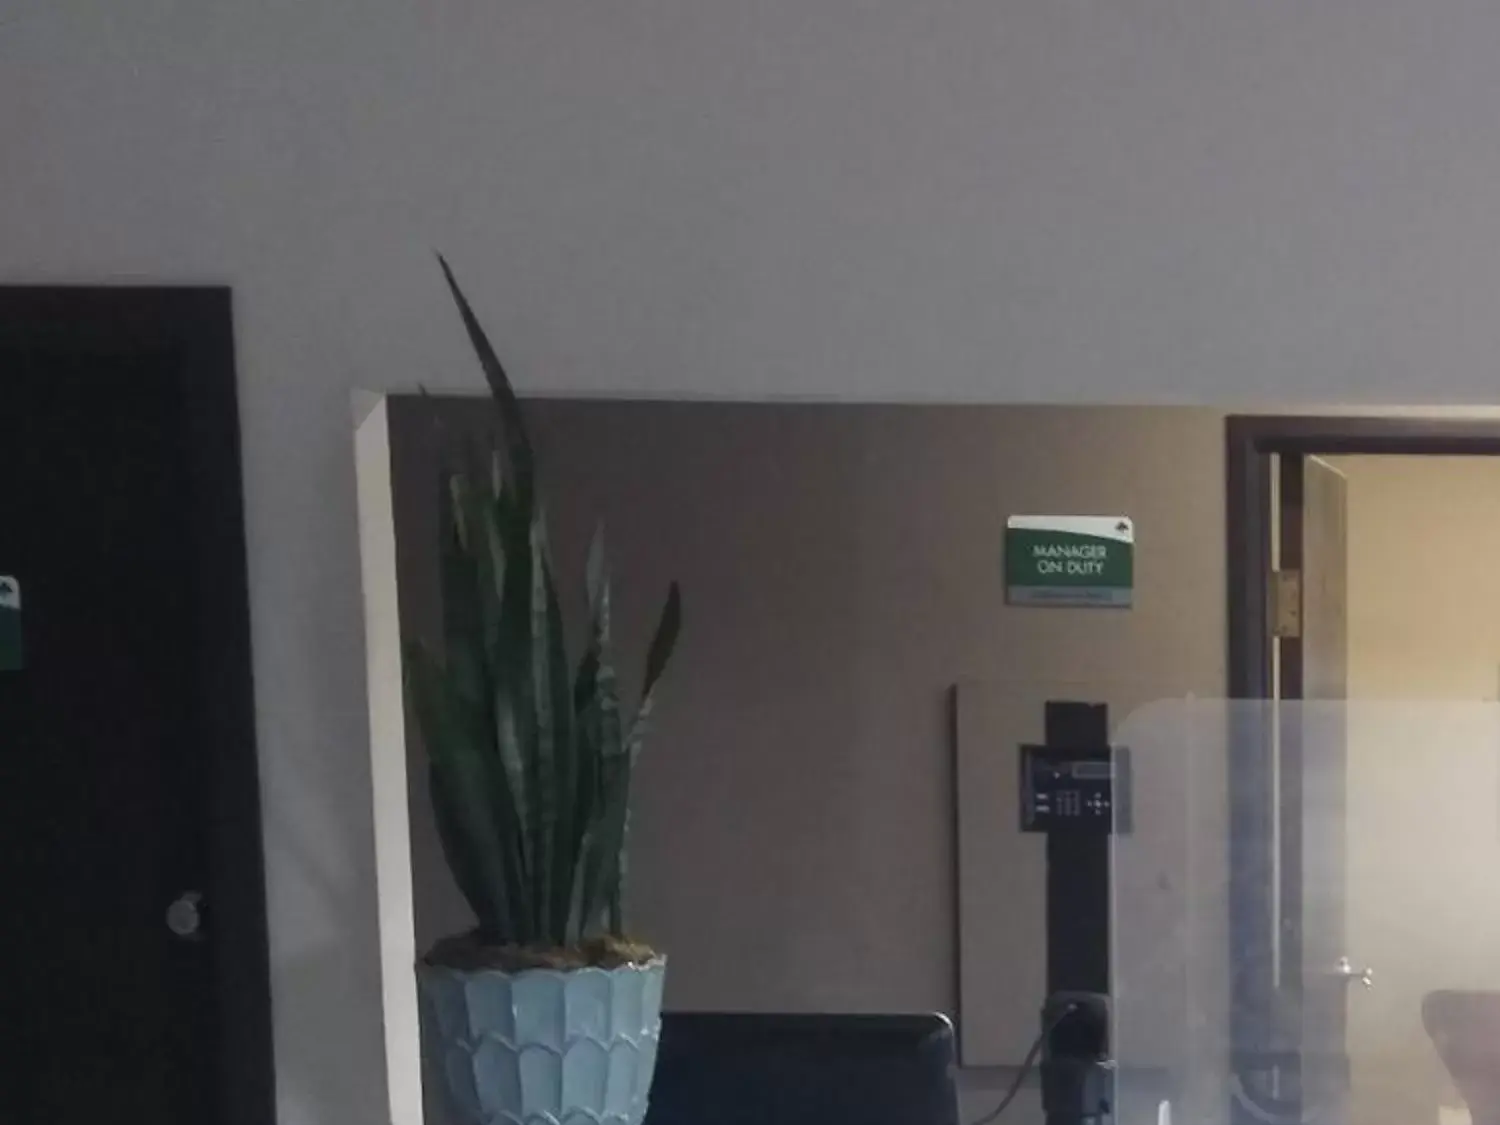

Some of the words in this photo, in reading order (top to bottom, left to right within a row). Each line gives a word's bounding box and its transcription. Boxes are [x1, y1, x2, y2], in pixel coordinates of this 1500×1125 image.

[1033, 544, 1106, 558] MANAGER
[1037, 560, 1063, 574] ON
[1067, 560, 1104, 574] DUTY
